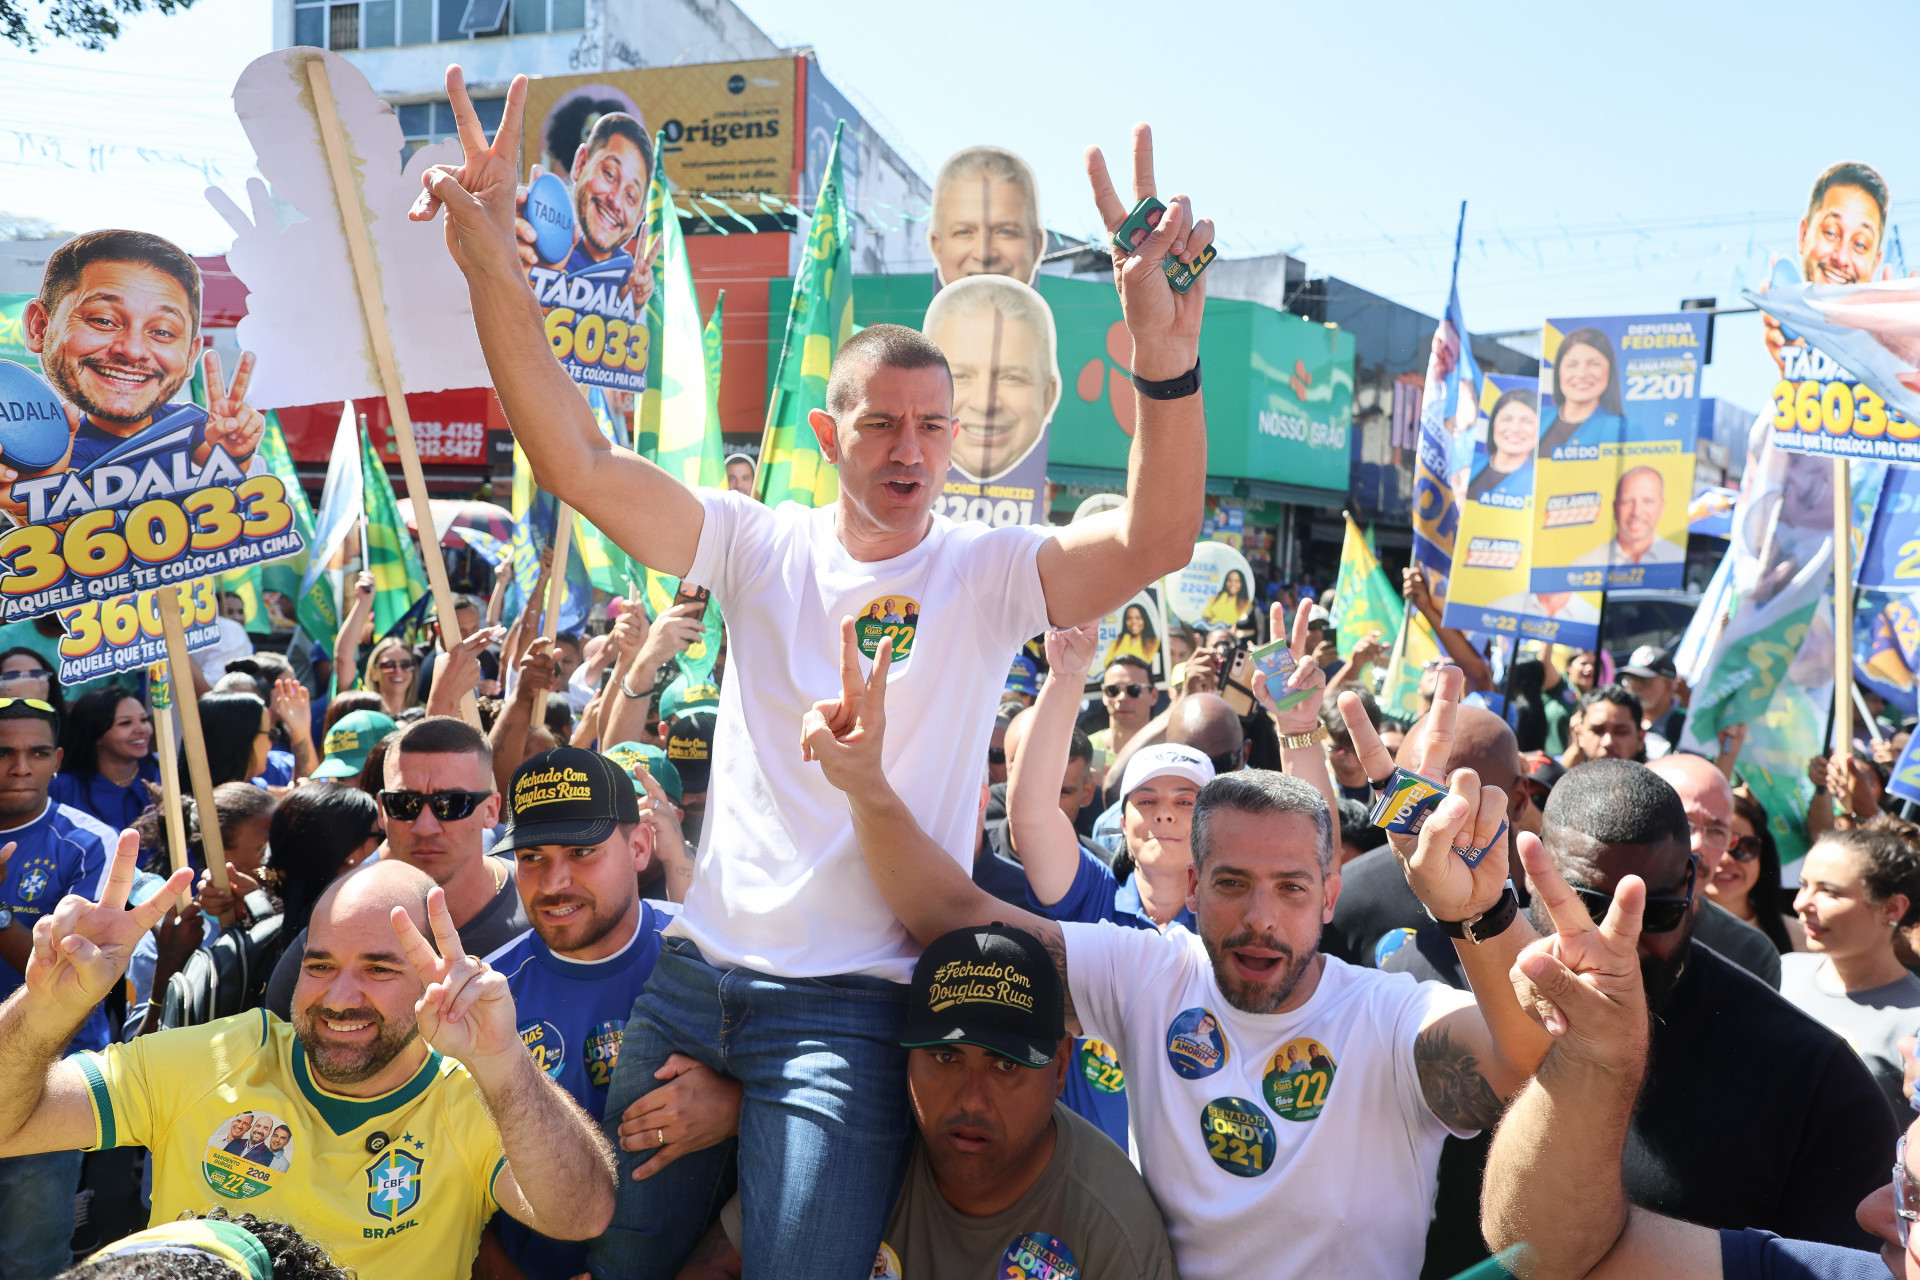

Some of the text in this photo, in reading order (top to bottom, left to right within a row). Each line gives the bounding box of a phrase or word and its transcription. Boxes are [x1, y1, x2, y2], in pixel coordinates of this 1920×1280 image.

[662, 118, 779, 147] Origens
[535, 201, 573, 231] TADALA
[530, 268, 635, 320] TADALA
[1628, 322, 1693, 335] DEPUTADA
[545, 308, 649, 372] 6033
[1622, 333, 1699, 350] FEDERAL
[1780, 346, 1857, 380] TADA
[615, 372, 629, 385] PRA
[1626, 374, 1695, 401] 2201
[1259, 410, 1307, 441] NOSSO
[415, 440, 482, 458] 212-5427
[1580, 446, 1599, 459] DO
[1602, 445, 1678, 456] BOLSONARO
[1875, 441, 1896, 456] PRA
[12, 445, 245, 522] TADALA
[943, 482, 1035, 500] RONEL MENEZES
[1507, 495, 1524, 509] DO
[0, 475, 293, 595] 36033
[89, 573, 130, 596] QUE
[134, 567, 157, 585] TE
[160, 554, 227, 579] COLOCA
[230, 543, 261, 564] PRA
[263, 533, 300, 554] CIMA
[1583, 571, 1603, 585] 22
[61, 578, 217, 658] 36033
[1497, 616, 1517, 631] 22
[205, 624, 220, 640] CIMA
[864, 625, 882, 635] Ruas
[884, 625, 914, 653] 22
[115, 645, 140, 665] QUE
[563, 767, 588, 782] Com
[515, 782, 591, 808] Douglas Ruas
[1390, 784, 1428, 825] VOTE!
[12, 906, 40, 914] BRASIL
[934, 961, 1031, 988] #Fechado Com
[928, 979, 1034, 1008] Douglas Ruas
[586, 1042, 620, 1063] JOR
[1175, 1042, 1209, 1063] AMORIM
[1099, 1064, 1123, 1090] 22
[1273, 1081, 1293, 1092] Ruas
[1294, 1071, 1327, 1108] 22
[1208, 1106, 1266, 1127] SENADOR
[1204, 1116, 1269, 1143] JORDY
[213, 1153, 240, 1166] SARGENTO
[1208, 1134, 1263, 1170] 221
[211, 1171, 226, 1182] Ruas
[222, 1174, 245, 1193] 22
[246, 1167, 270, 1181] 2208
[383, 1177, 405, 1189] CBF
[363, 1219, 418, 1239] BRASIL
[1021, 1237, 1076, 1276] SENADOR
